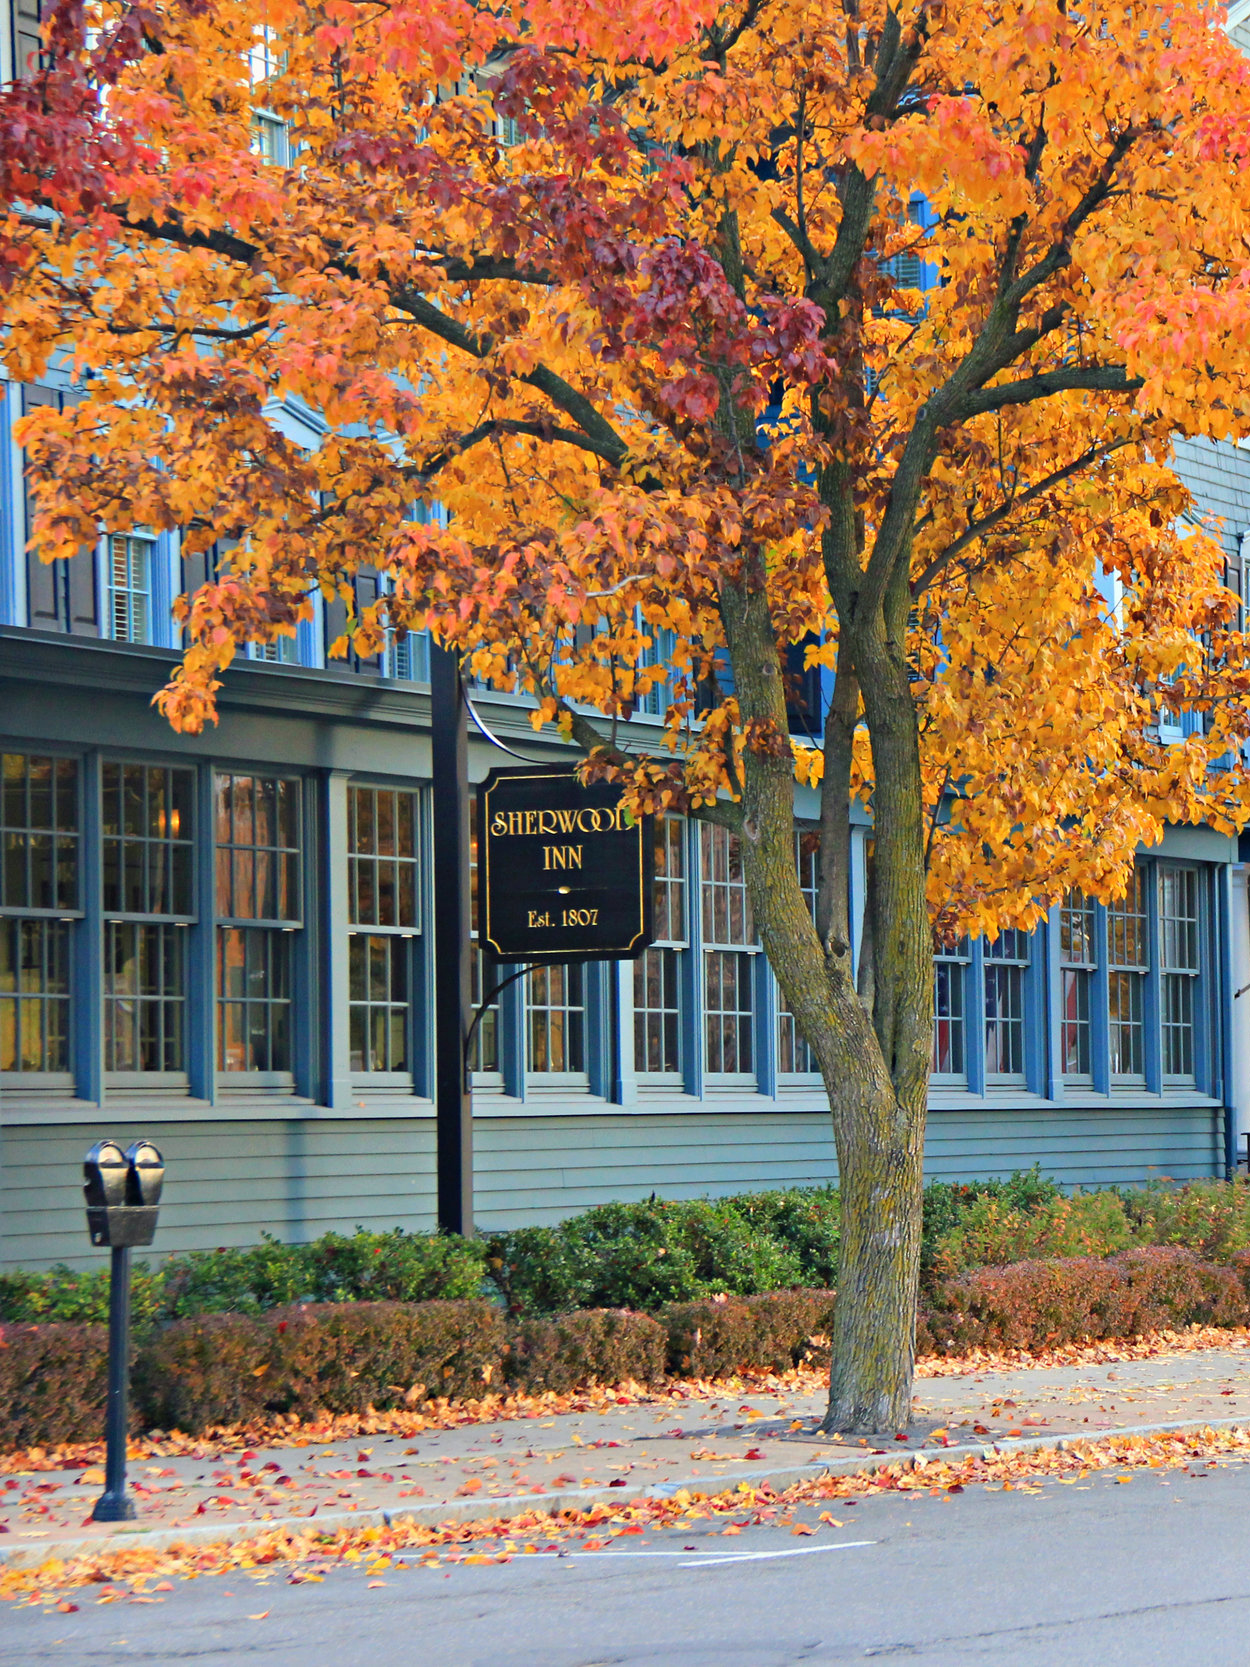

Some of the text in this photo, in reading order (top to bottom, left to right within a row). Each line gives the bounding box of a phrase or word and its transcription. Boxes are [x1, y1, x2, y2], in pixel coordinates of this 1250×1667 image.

[542, 845, 583, 870] INN
[528, 909, 599, 928] Est. 1807
